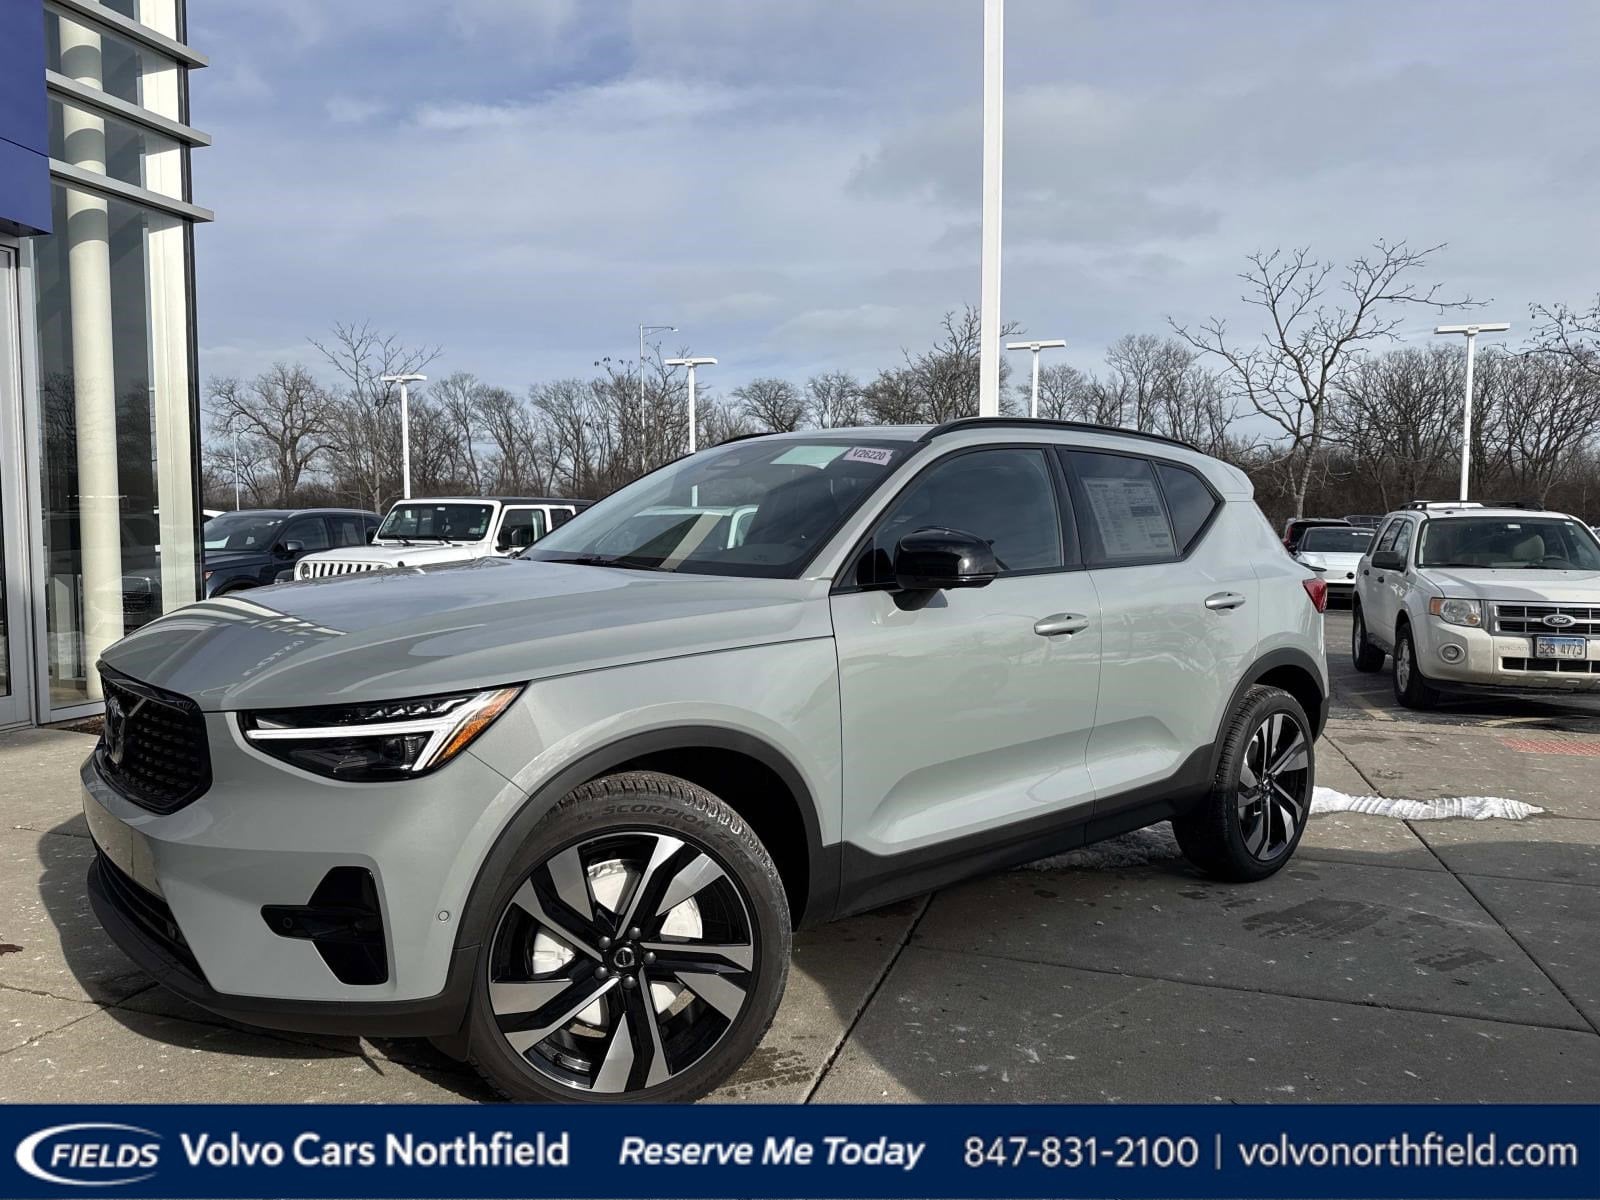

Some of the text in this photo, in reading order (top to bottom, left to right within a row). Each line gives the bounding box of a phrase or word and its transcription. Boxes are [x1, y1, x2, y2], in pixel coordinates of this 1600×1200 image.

[853, 448, 887, 461] V26220
[1560, 644, 1583, 655] 4773
[601, 803, 711, 829] SCORPION
[714, 830, 759, 874] ZERO
